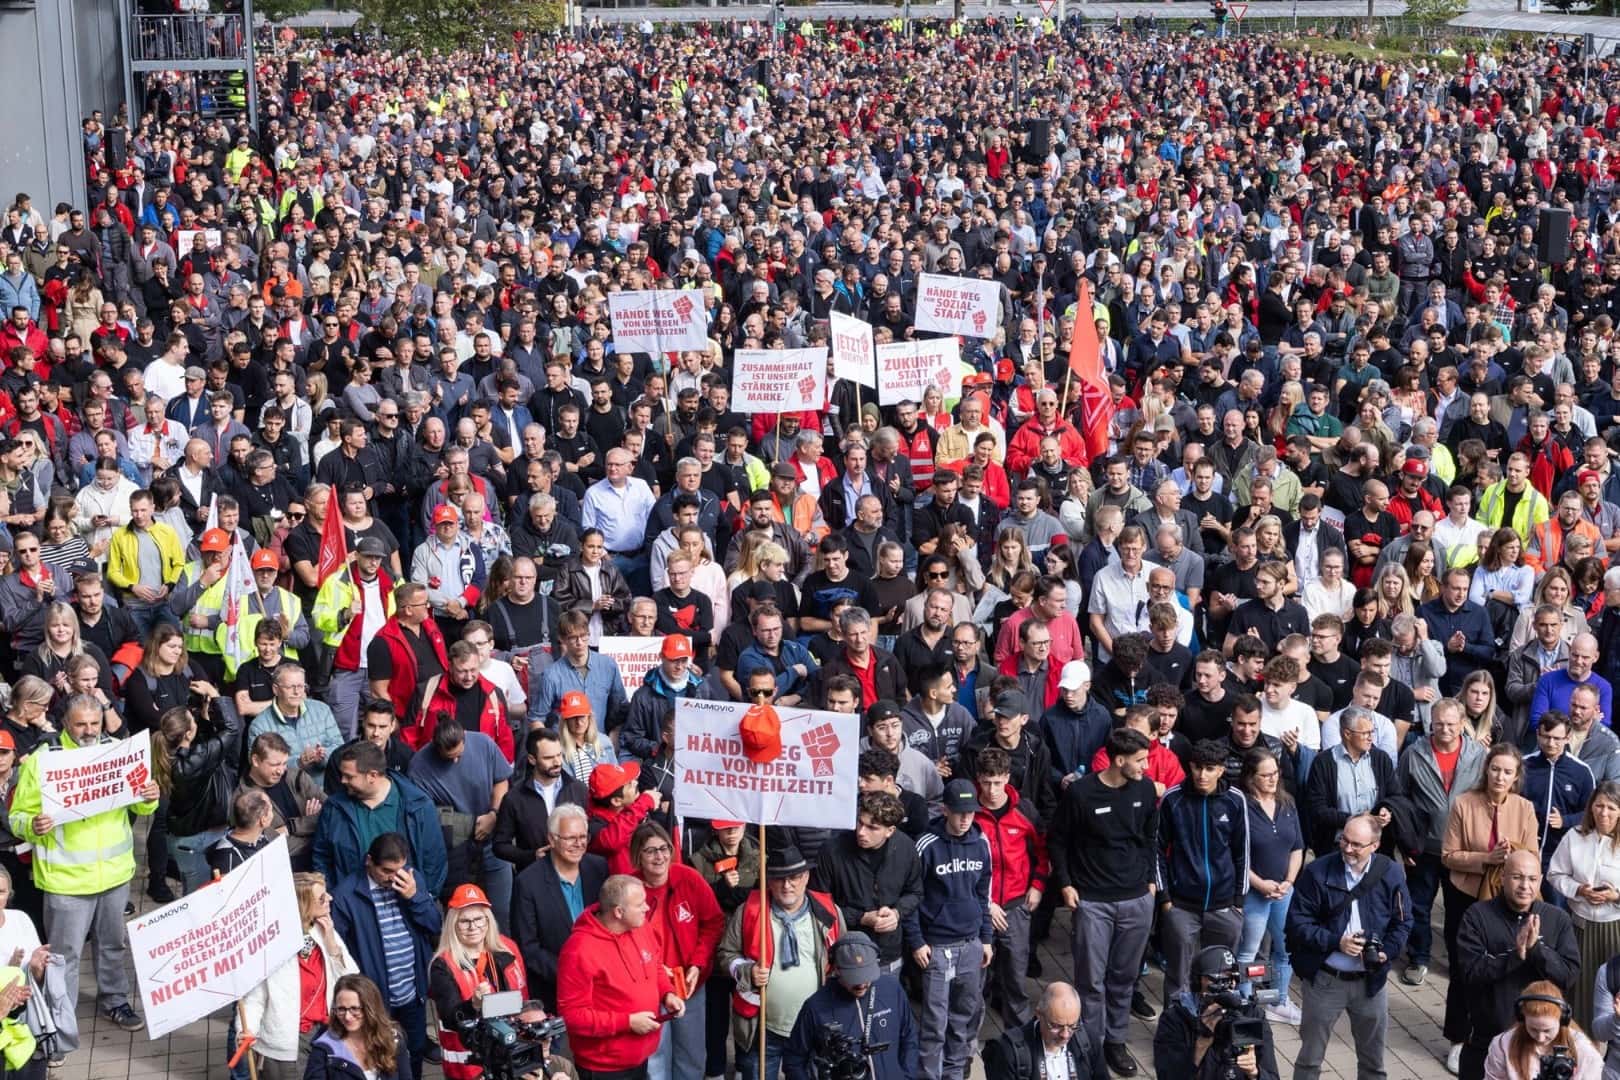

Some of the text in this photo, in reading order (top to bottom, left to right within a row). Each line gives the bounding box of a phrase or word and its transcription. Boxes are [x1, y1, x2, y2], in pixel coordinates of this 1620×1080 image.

[927, 286, 980, 302] HÄNDE WEG
[936, 298, 976, 311] SOZIAL-
[616, 309, 674, 320] HÄNDE WEG
[934, 308, 967, 320] STAAT
[623, 320, 641, 328] VON
[741, 362, 813, 372] ZUSAMMENHALT
[885, 354, 944, 371] ZUKUNFT
[767, 372, 799, 380] UNSERE
[898, 369, 929, 380] STATT
[740, 382, 791, 391] STÄRKSTE
[747, 392, 785, 401] MARKE.
[694, 702, 735, 713] AUMOVIO
[687, 733, 801, 761] HÄND EG
[46, 749, 145, 782] ZUSAMMENHALT
[722, 758, 797, 777] VON DER
[56, 769, 122, 792] IST UNSERE
[683, 769, 833, 795] ALTERSTEILZEIT!
[63, 781, 124, 808] STÄRKE!
[936, 858, 983, 875] adidas
[147, 903, 189, 926] AUMOVIO
[149, 885, 271, 959] VORSTÄNDE VERSAGEN,
[181, 909, 259, 959] BESCHÄFTIGTE
[174, 919, 258, 974] SOLLEN ZAHLEN?
[150, 920, 281, 1006] NICHT MIT UNS!
